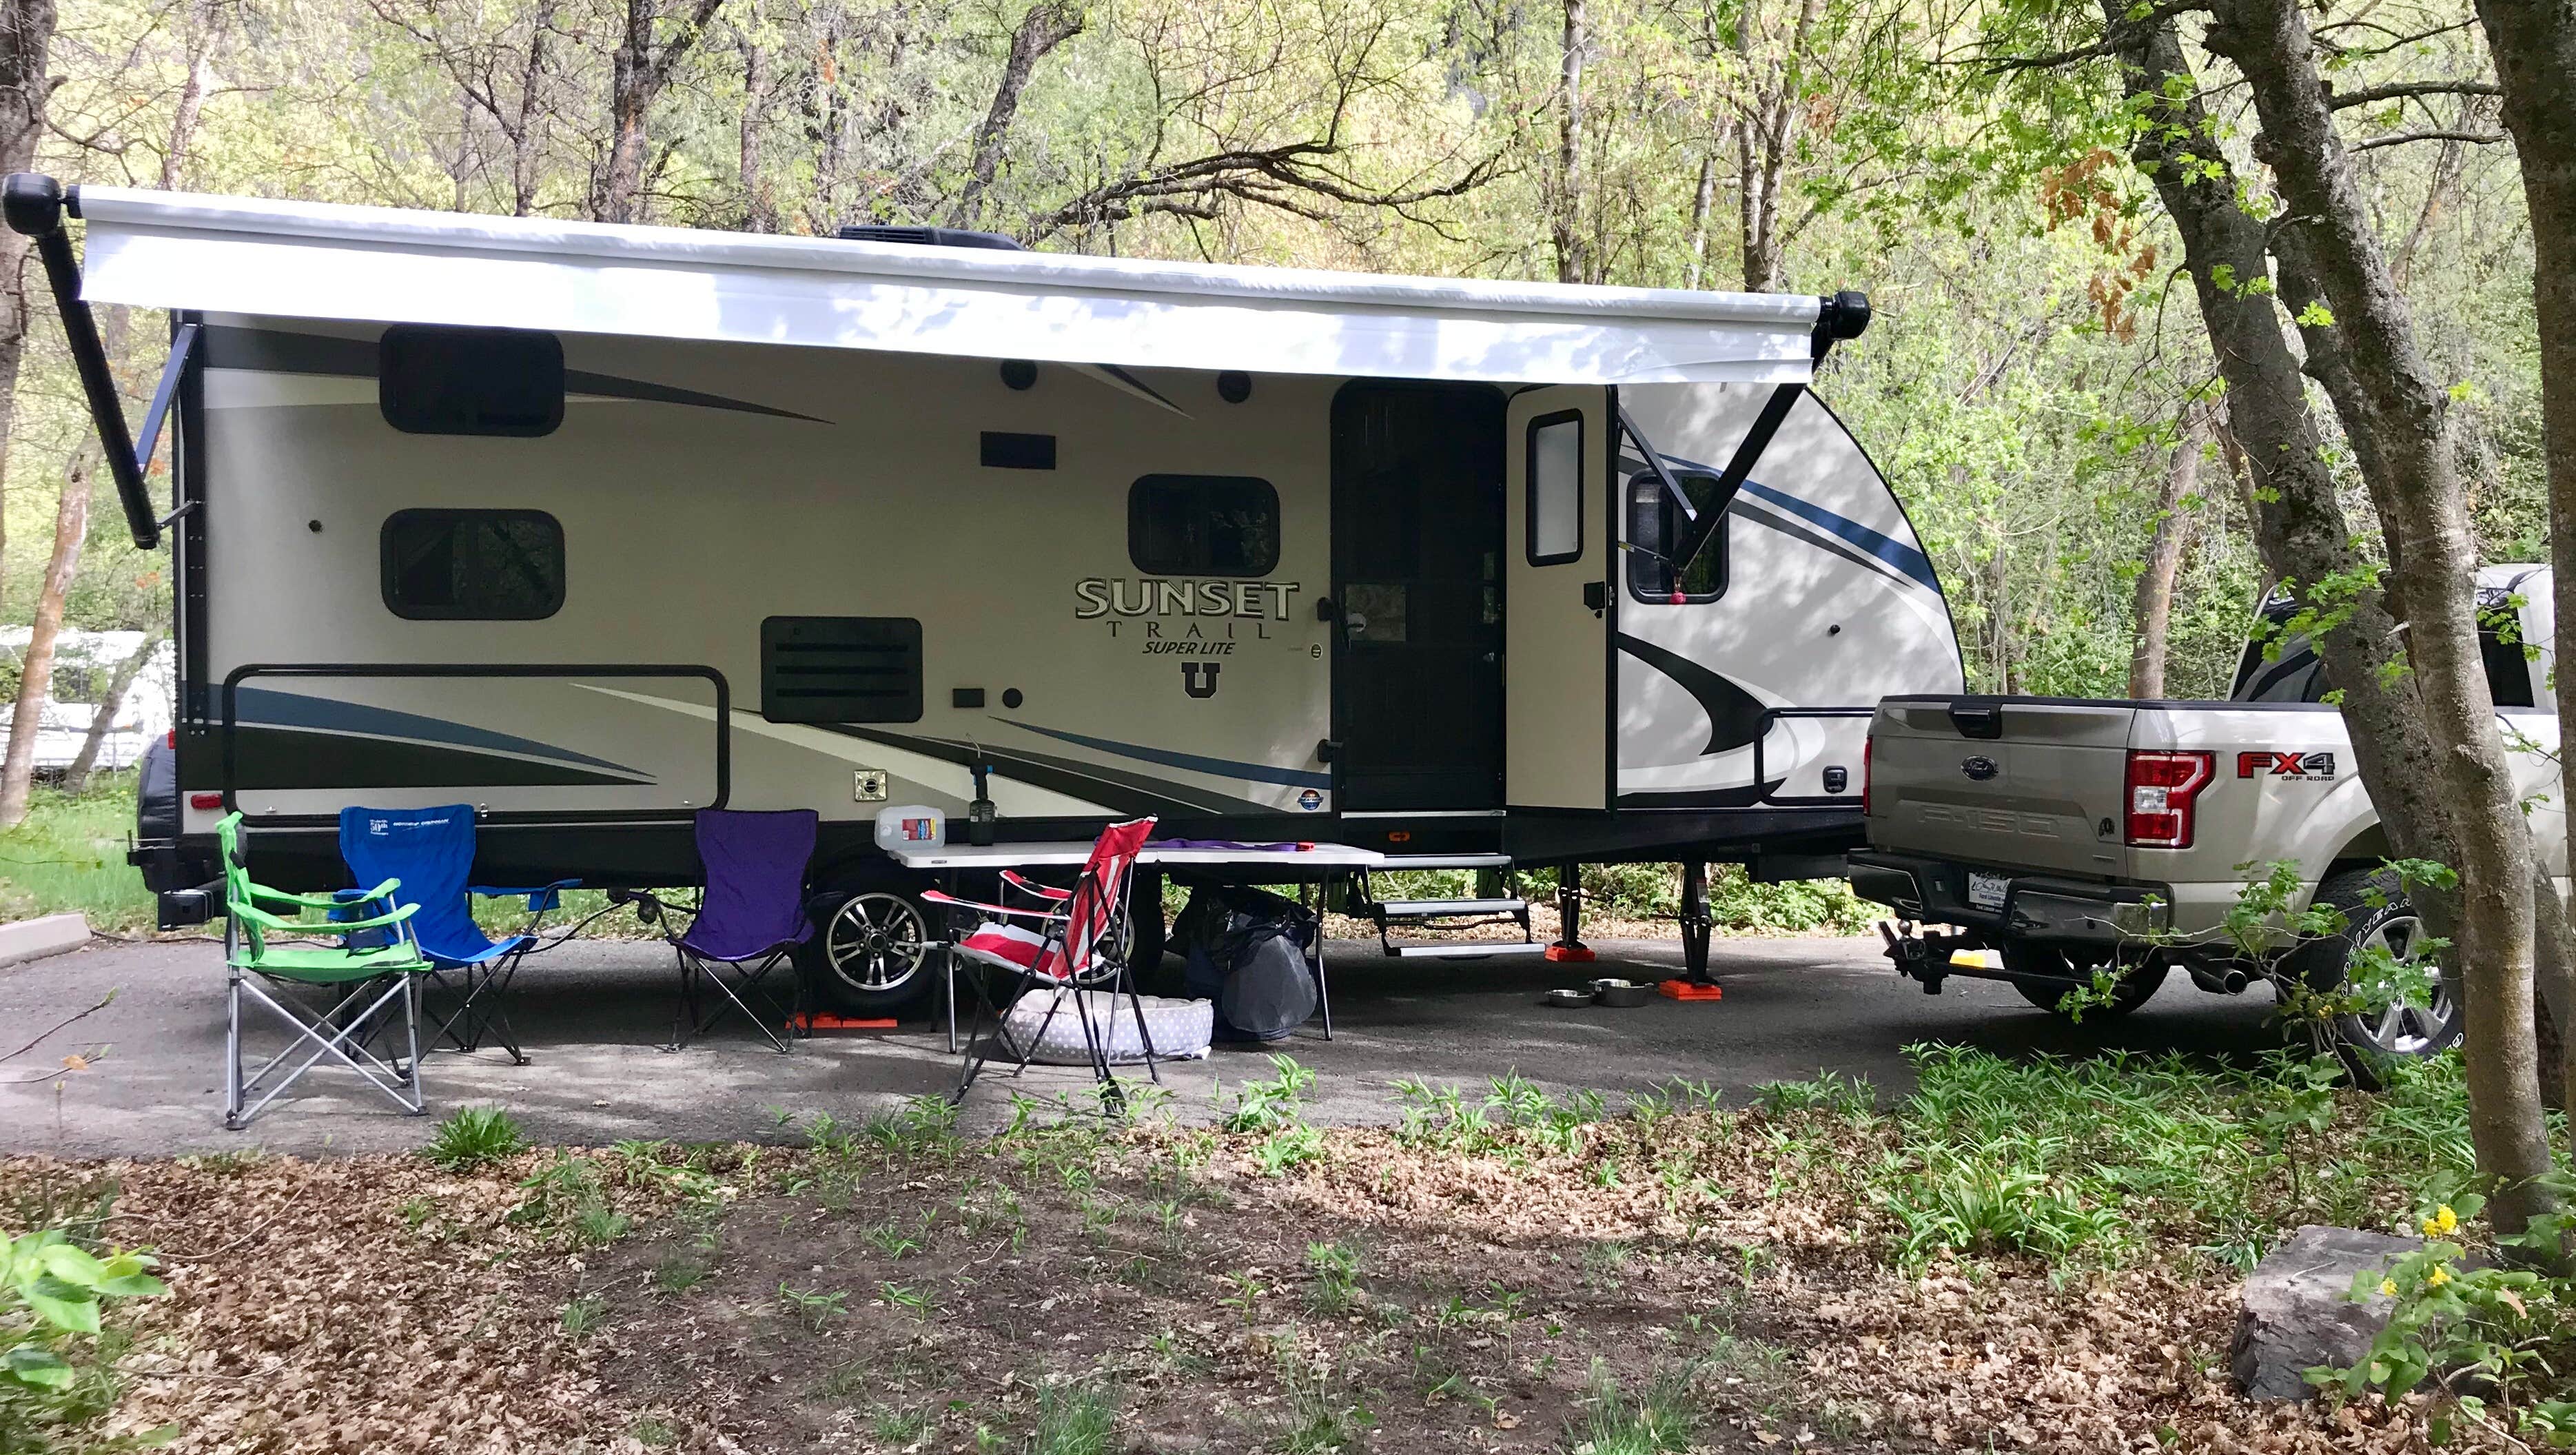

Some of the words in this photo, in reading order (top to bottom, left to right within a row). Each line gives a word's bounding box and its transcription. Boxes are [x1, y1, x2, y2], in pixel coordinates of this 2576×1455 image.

[1075, 577, 1300, 622] SUNSET
[1106, 621, 1271, 640] TRAIL
[1142, 641, 1200, 655] SUPER
[1200, 642, 1236, 655] LITE
[1180, 662, 1220, 698] U
[2237, 751, 2335, 779] FX4
[1917, 804, 2061, 838] F-150
